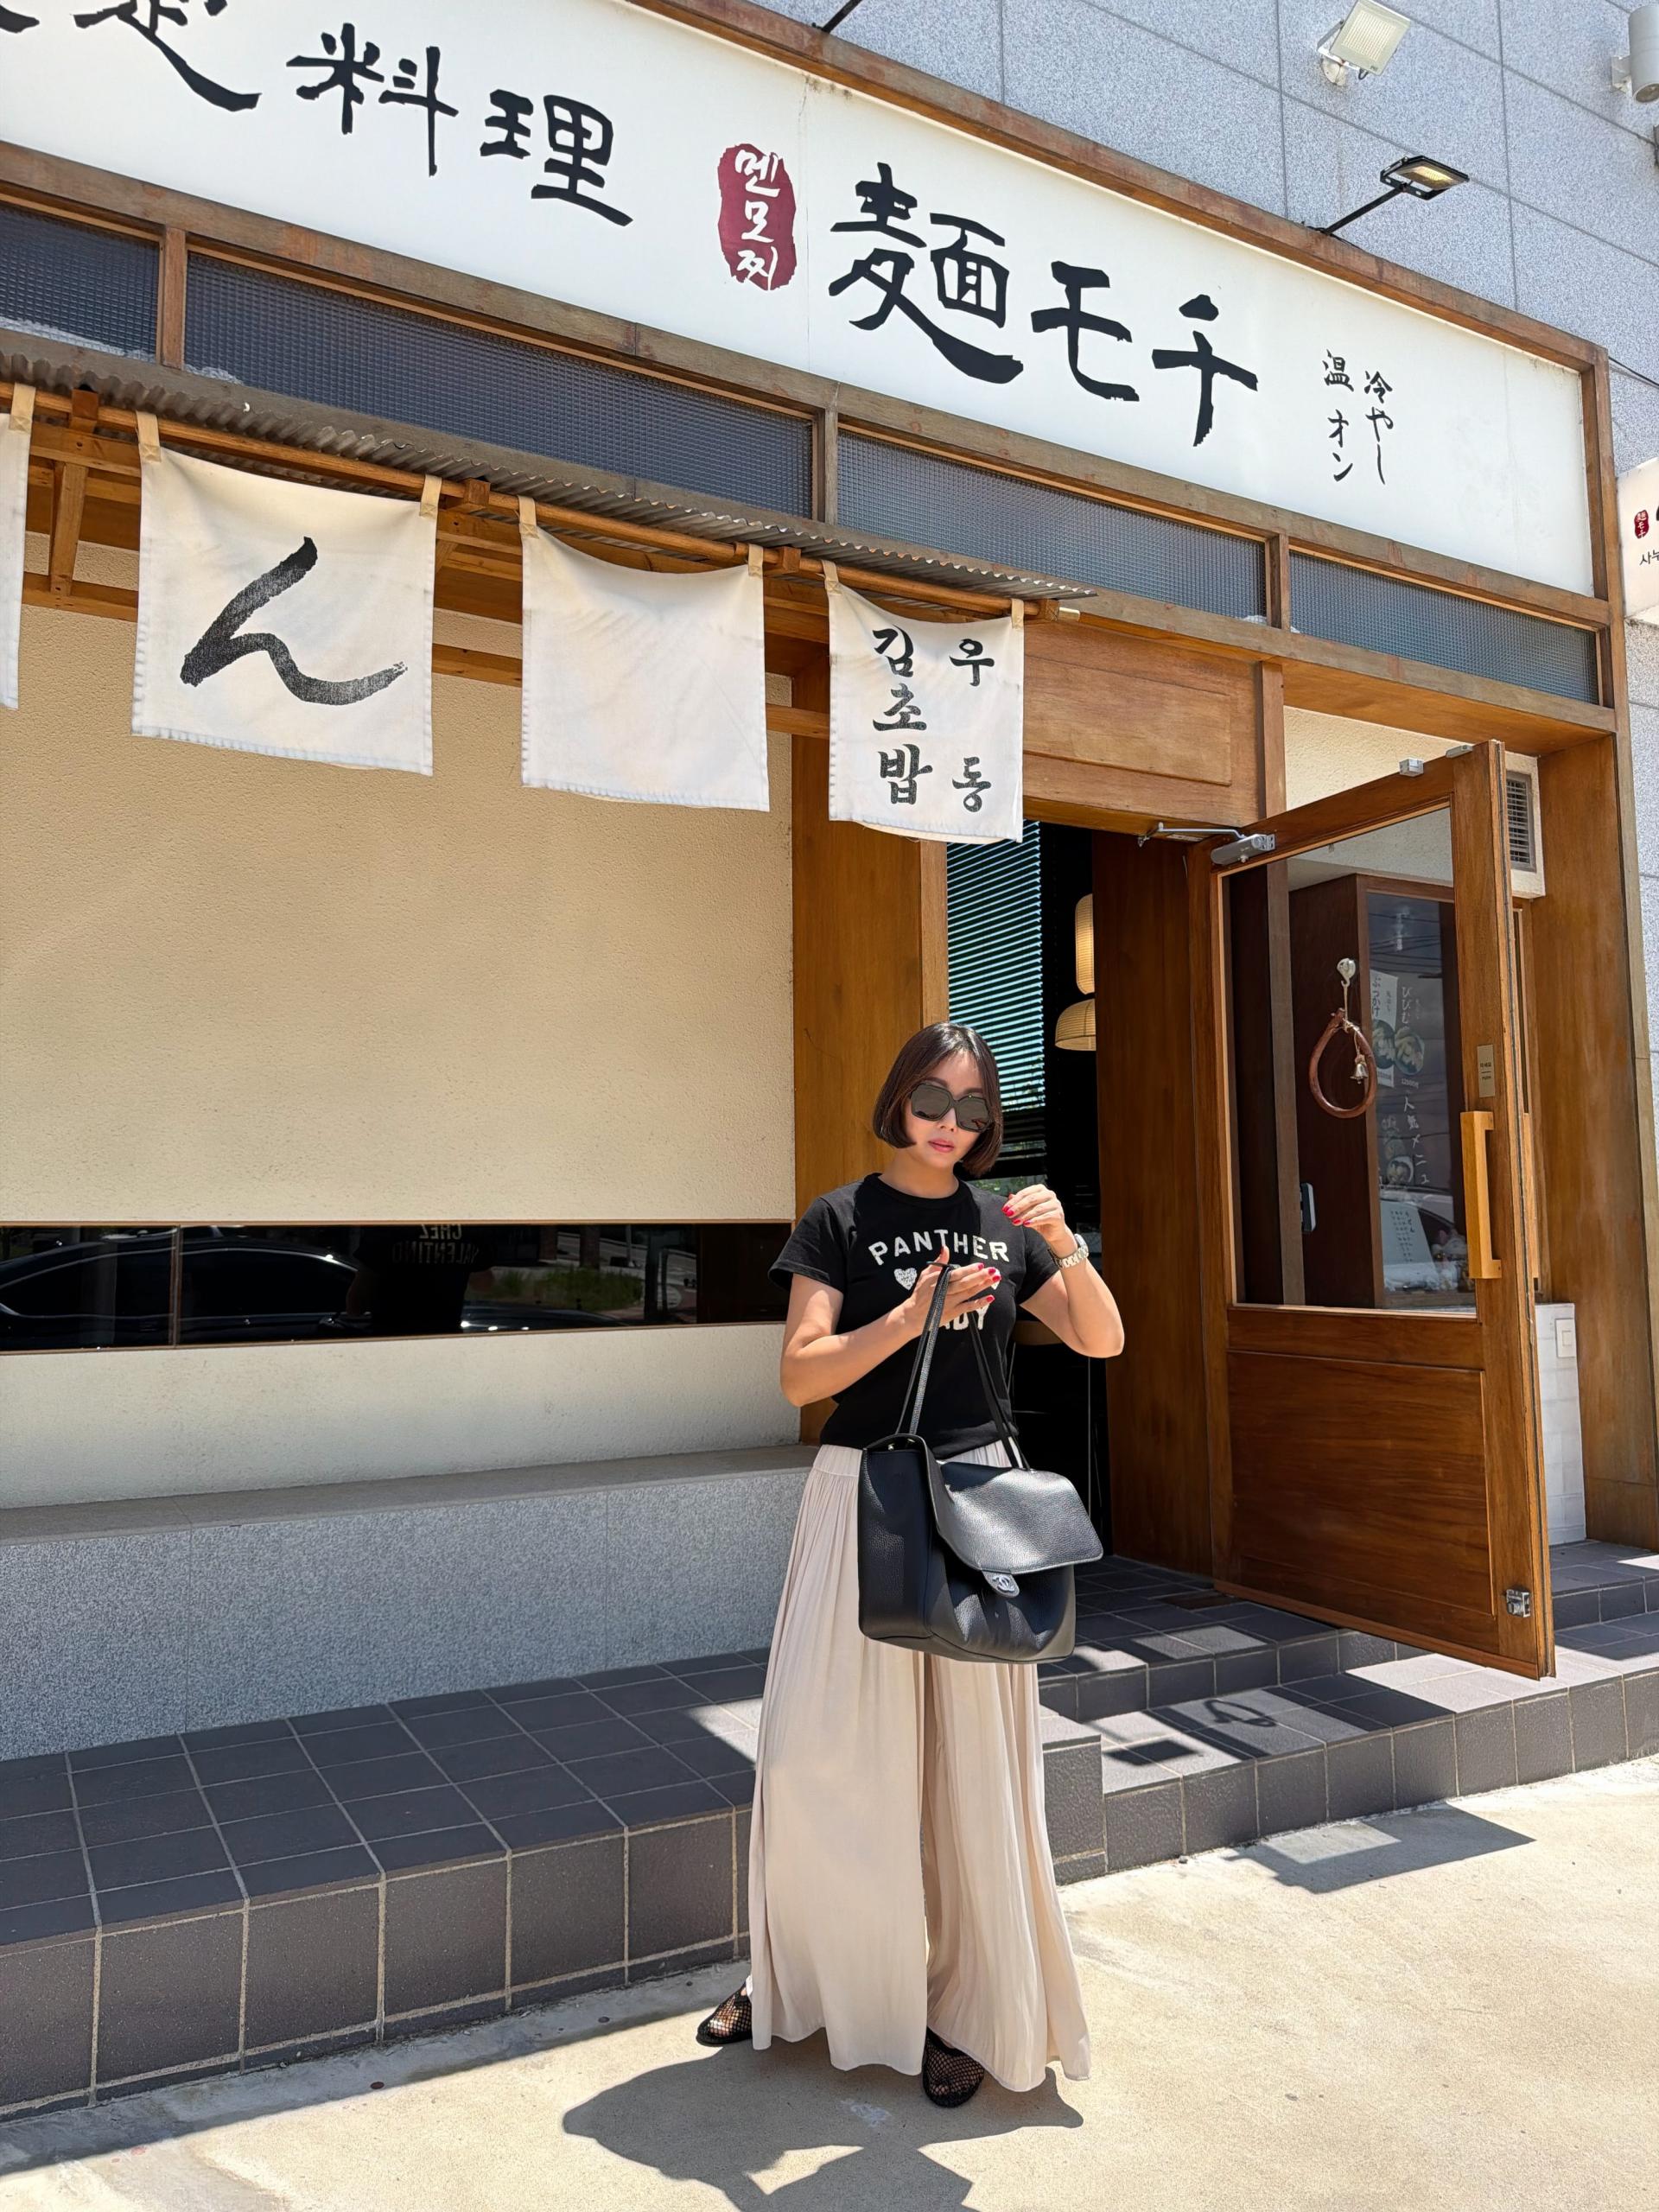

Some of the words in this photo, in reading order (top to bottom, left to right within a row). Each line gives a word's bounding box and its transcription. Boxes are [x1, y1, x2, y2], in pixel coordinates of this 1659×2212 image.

[180, 536, 408, 705] ん
[873, 625, 933, 805] 김초밥
[950, 638, 995, 812] 우동
[868, 1229, 1009, 1265] PANTHER
